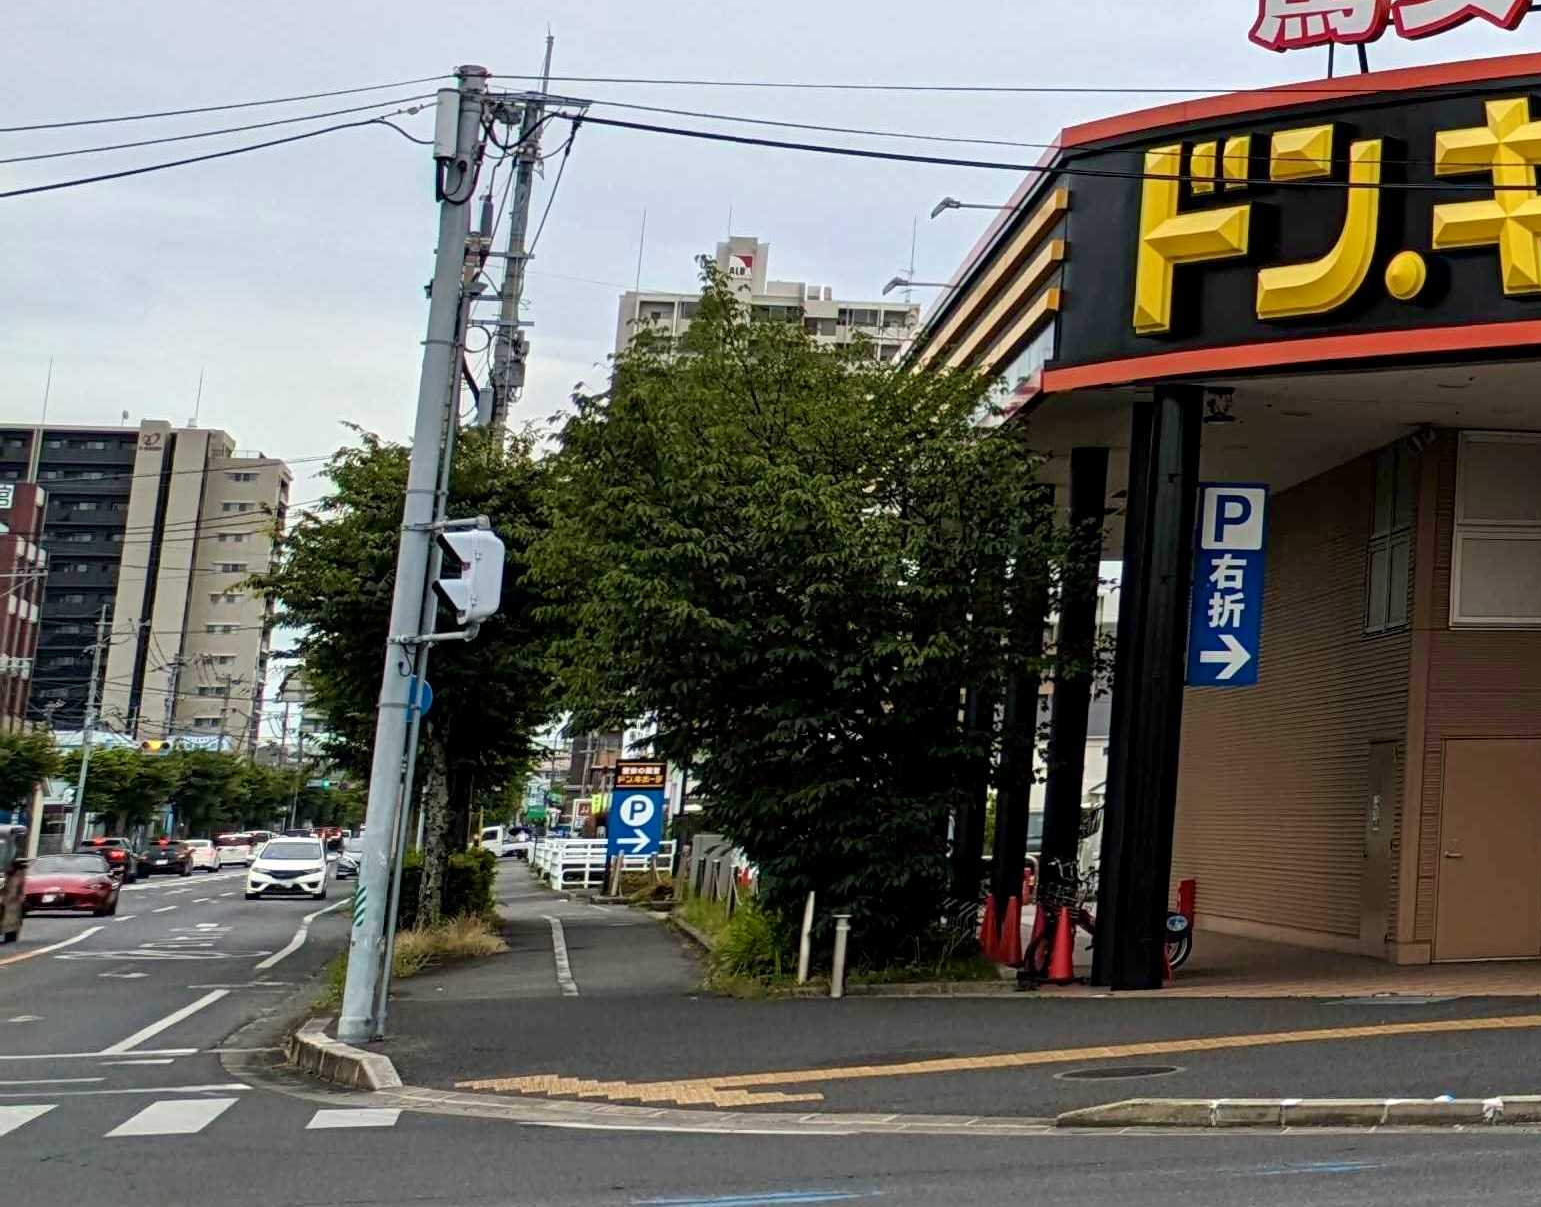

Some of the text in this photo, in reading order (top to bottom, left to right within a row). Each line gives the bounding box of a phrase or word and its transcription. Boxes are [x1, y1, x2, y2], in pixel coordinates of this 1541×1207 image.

[1213, 494, 1252, 542] P
[1208, 553, 1247, 628] 右折
[629, 800, 647, 821] P
